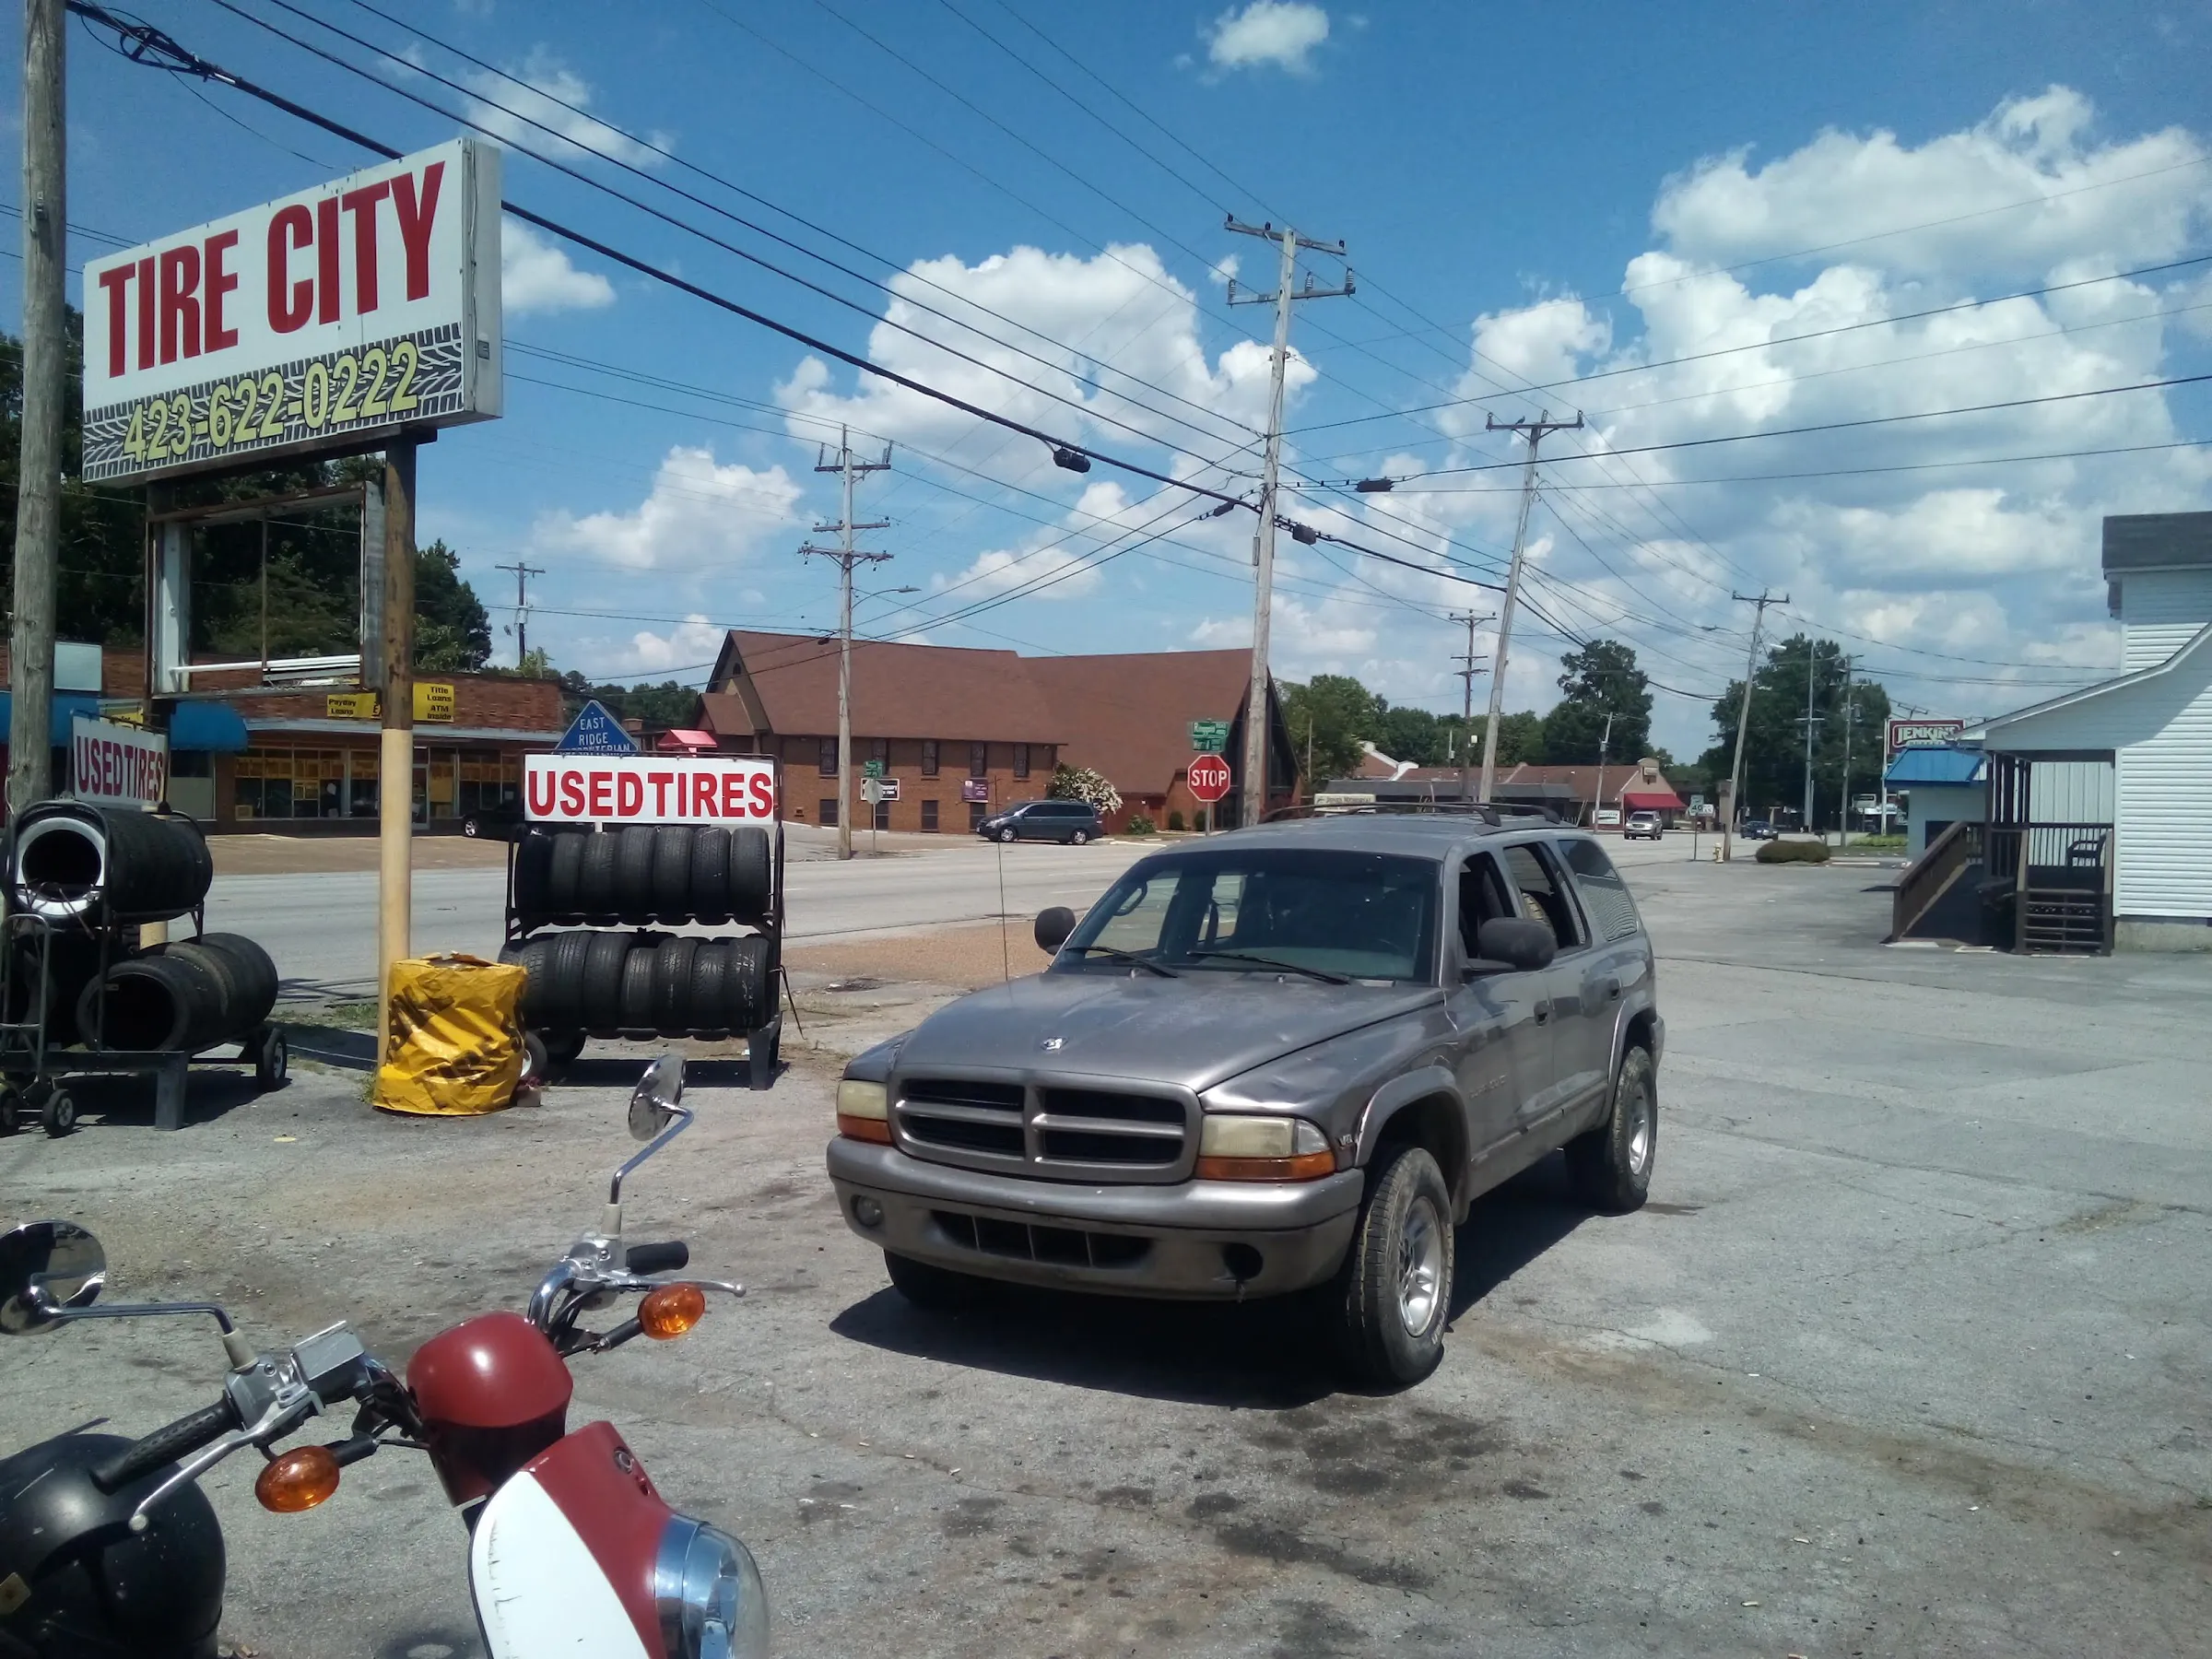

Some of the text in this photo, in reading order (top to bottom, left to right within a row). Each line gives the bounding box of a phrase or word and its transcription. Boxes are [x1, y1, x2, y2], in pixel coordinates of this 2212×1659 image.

[99, 160, 445, 379] TIRE CITY
[122, 340, 420, 464] 423-622-0222
[328, 699, 357, 707] Payday
[430, 704, 449, 712] ATM
[580, 717, 606, 731] EAST
[579, 733, 608, 746] RIDGE
[1191, 770, 1228, 787] STOP
